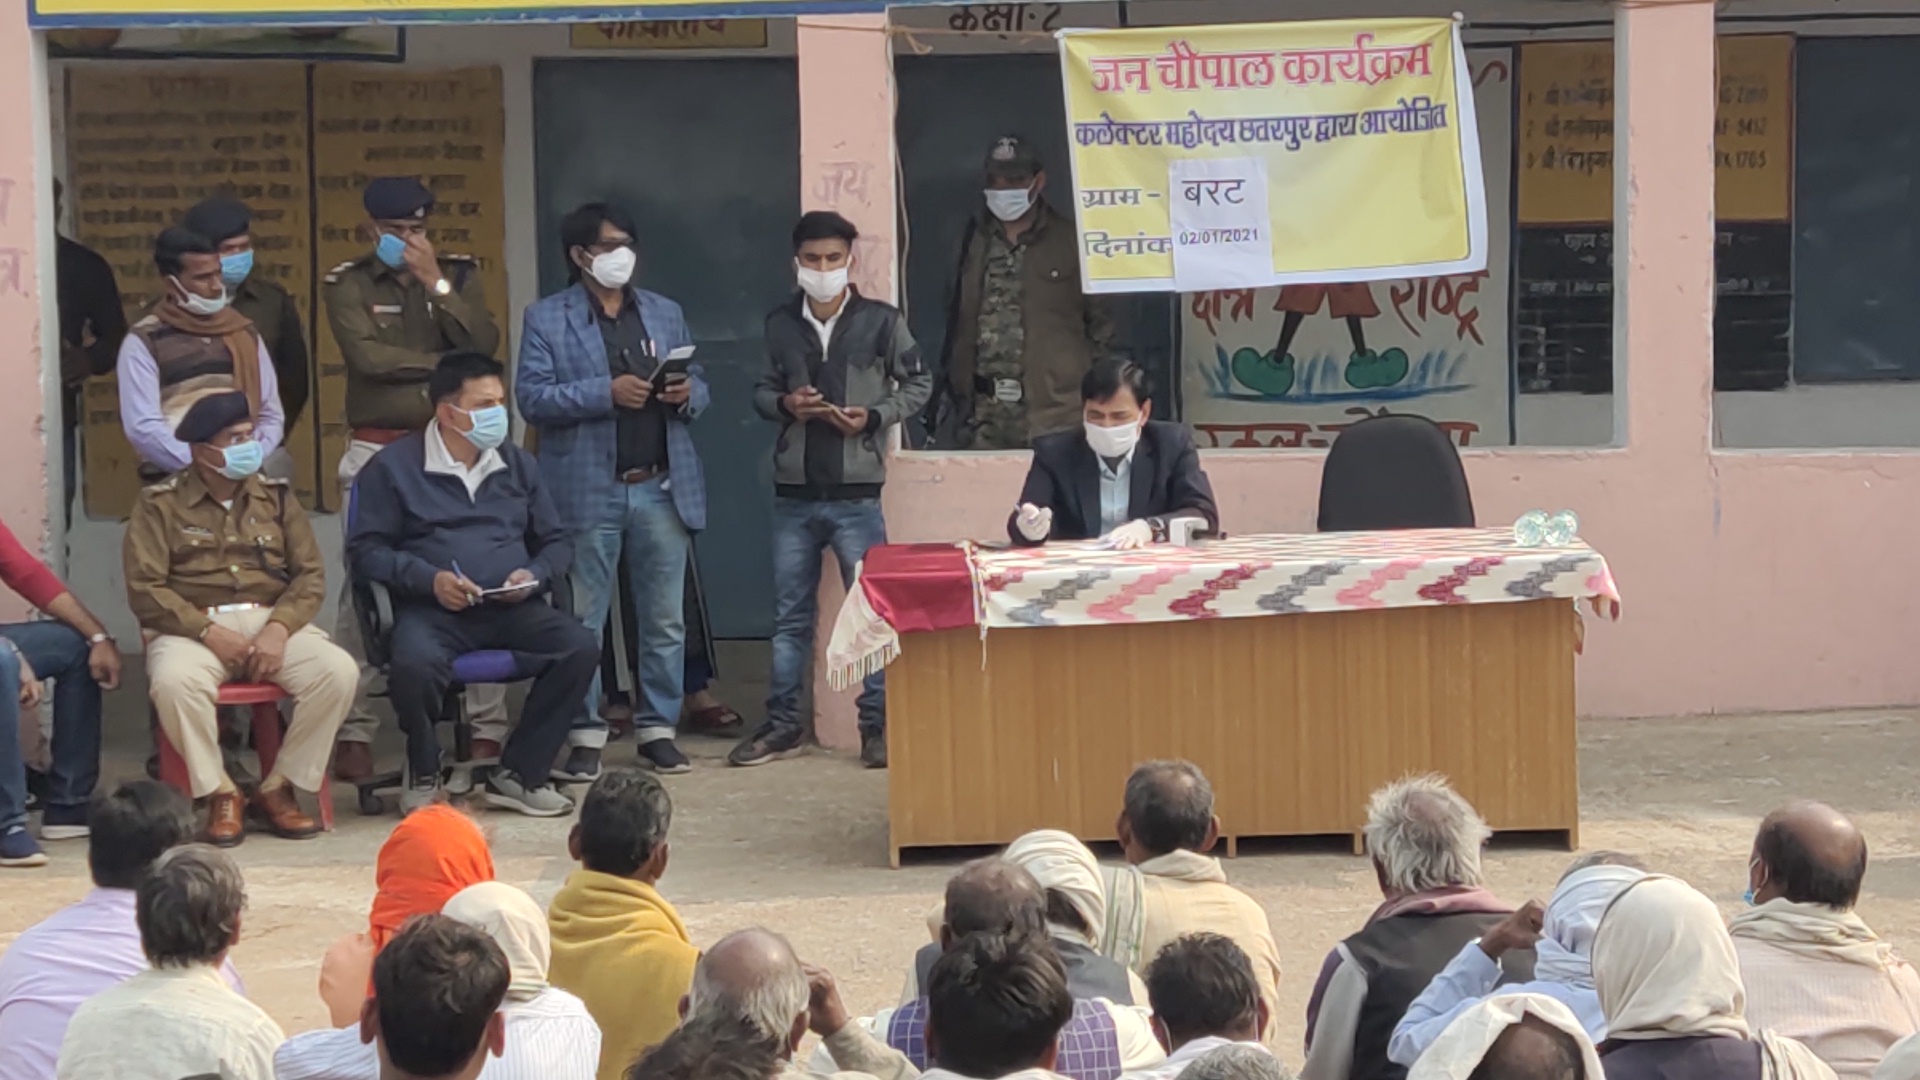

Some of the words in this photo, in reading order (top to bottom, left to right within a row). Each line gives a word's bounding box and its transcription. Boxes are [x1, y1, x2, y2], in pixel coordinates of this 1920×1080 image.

[1091, 56, 1150, 92] जन
[1155, 40, 1276, 89] चौपाल
[1281, 33, 1432, 85] कार्यक्रम
[1074, 111, 1162, 146] कलेक्टर
[1164, 109, 1236, 149] महोदय
[1238, 115, 1313, 151] छतरपुर
[1314, 112, 1358, 142] द्वारा
[1360, 96, 1447, 135] आयोजित
[1081, 188, 1142, 208] ग्राम
[1181, 179, 1246, 207] बरट
[1084, 231, 1173, 258] दिनांक
[1179, 228, 1258, 246] 02/01/2021
